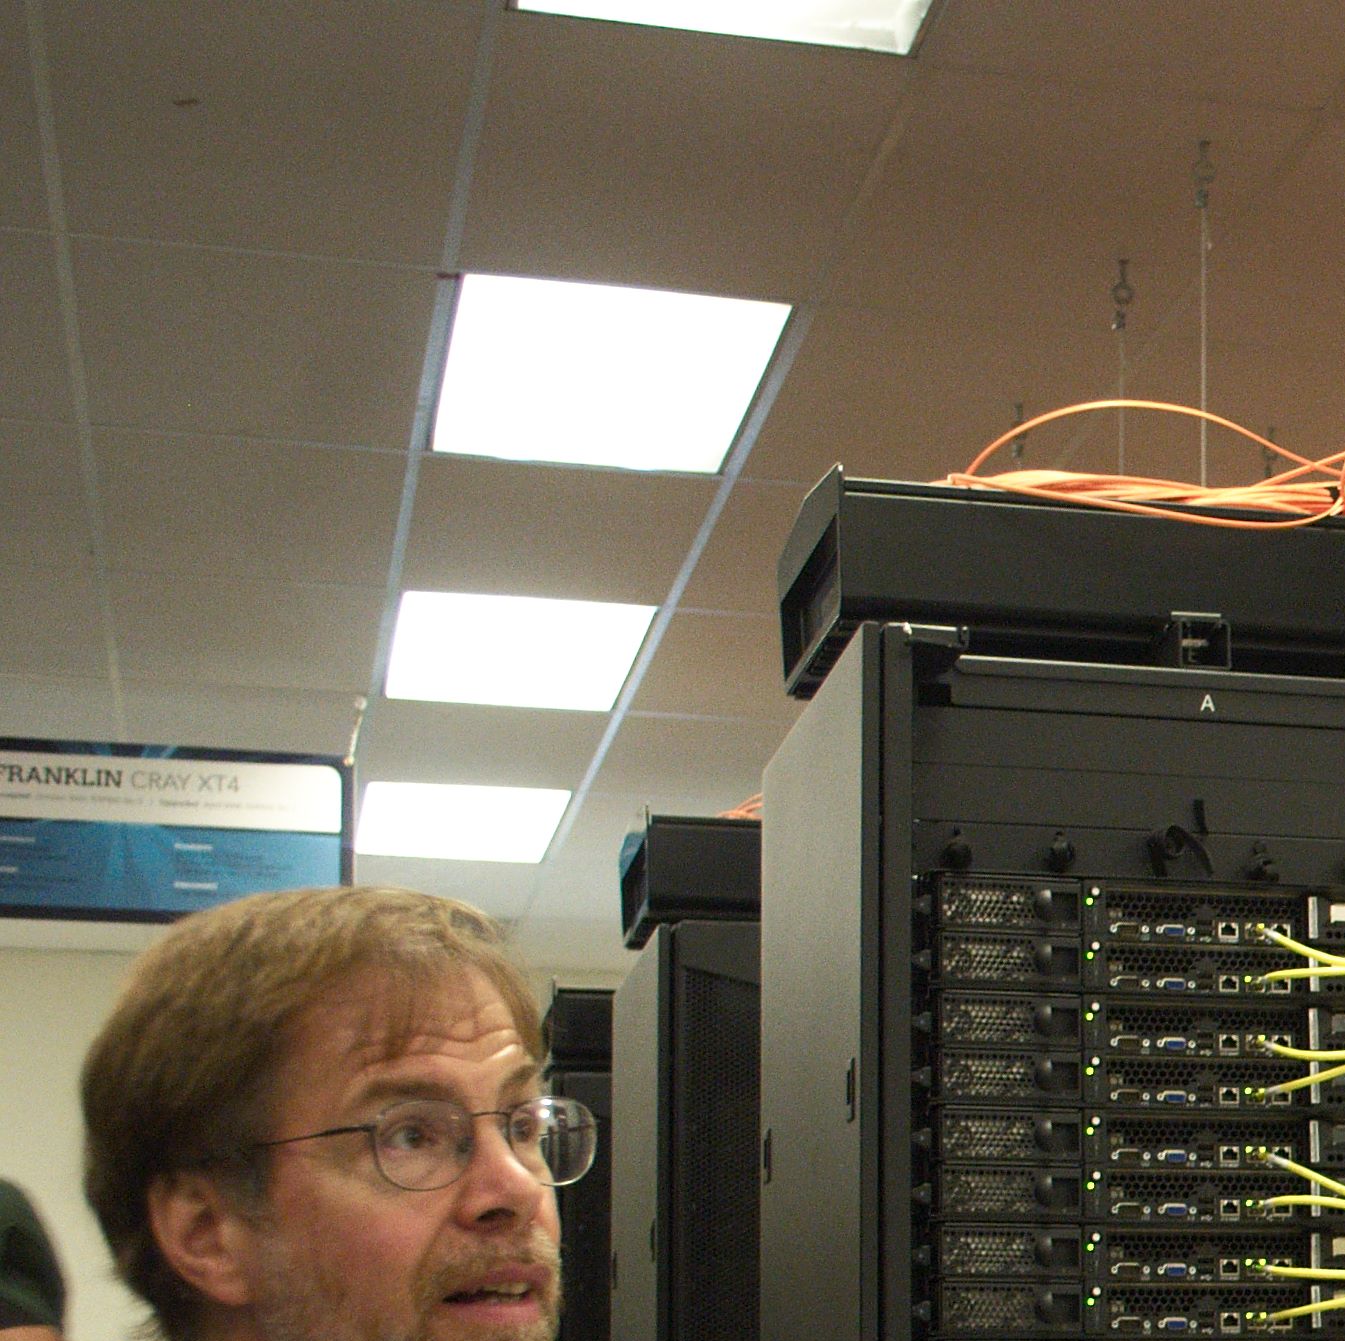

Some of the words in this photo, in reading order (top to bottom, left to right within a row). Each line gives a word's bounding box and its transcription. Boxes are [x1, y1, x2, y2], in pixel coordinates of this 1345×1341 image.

[1200, 693, 1215, 713] A
[131, 770, 192, 793] CRAY
[198, 773, 240, 793] XT4
